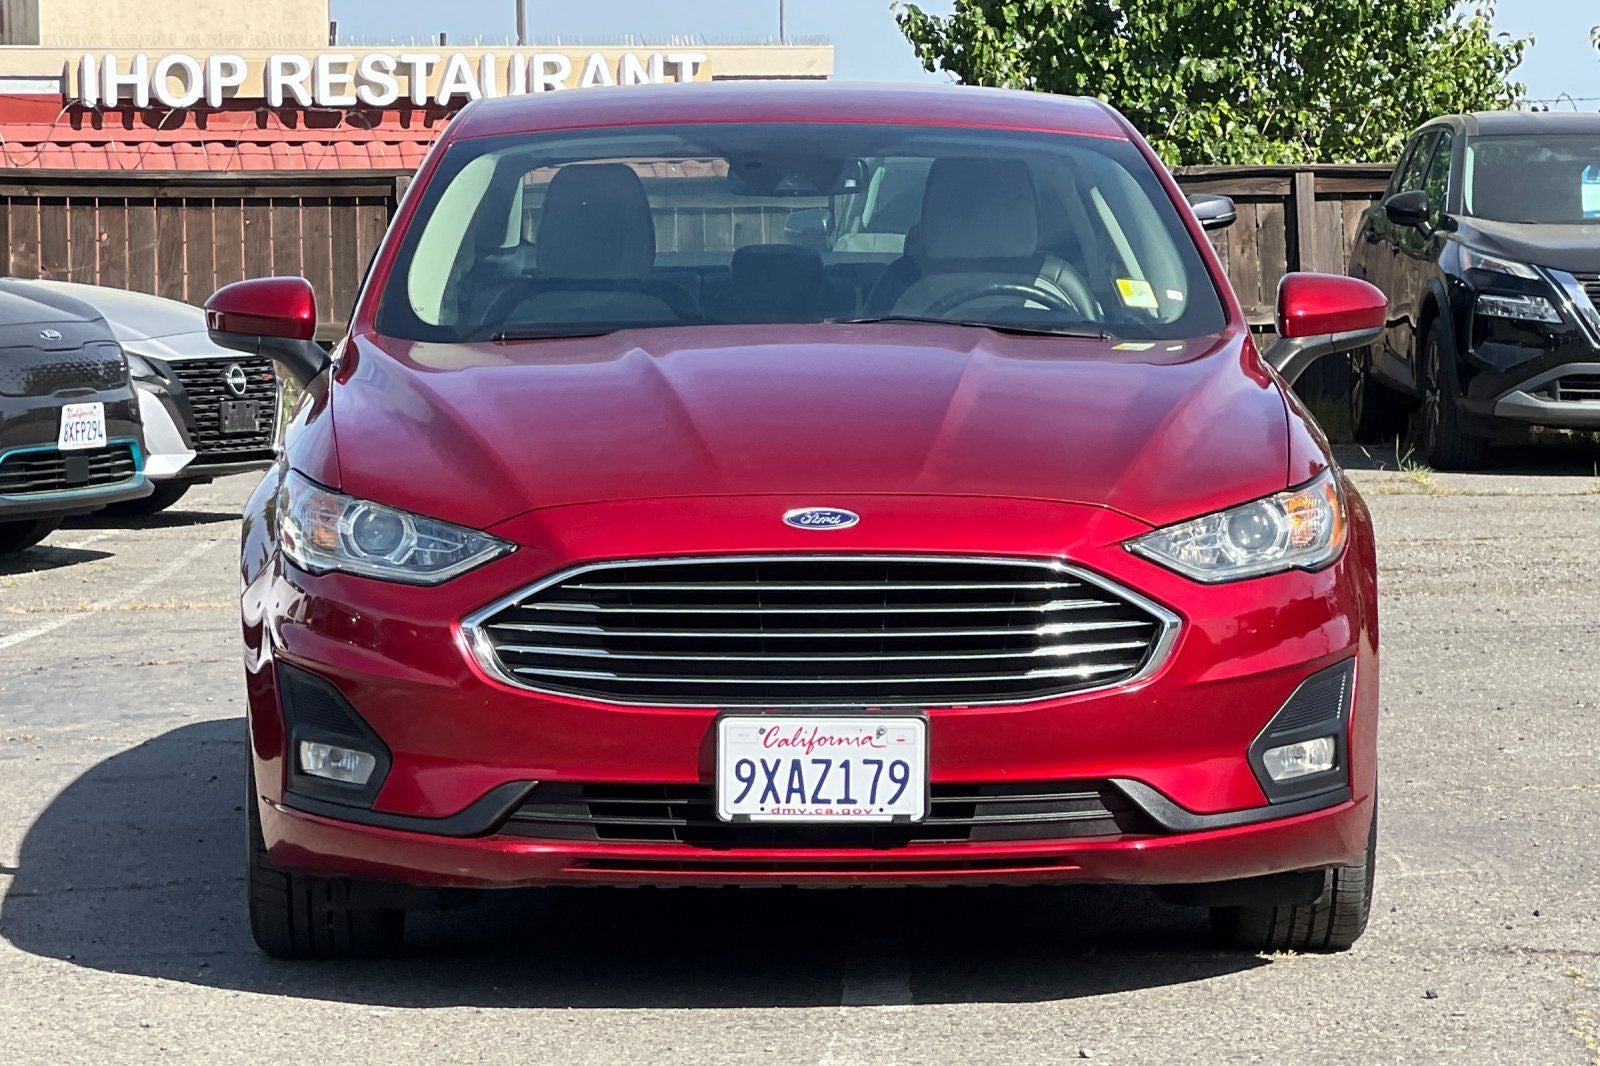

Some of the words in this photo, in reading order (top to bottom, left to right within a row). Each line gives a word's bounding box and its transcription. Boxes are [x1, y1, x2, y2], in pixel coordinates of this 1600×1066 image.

[79, 53, 248, 108] IHOP
[267, 52, 707, 107] RESTAURANT
[64, 420, 103, 442] 8XFP294
[800, 512, 841, 524] Ford
[763, 725, 886, 755] California
[733, 758, 911, 805] 9XAZ179
[770, 806, 874, 815] dmv.ca.gov
